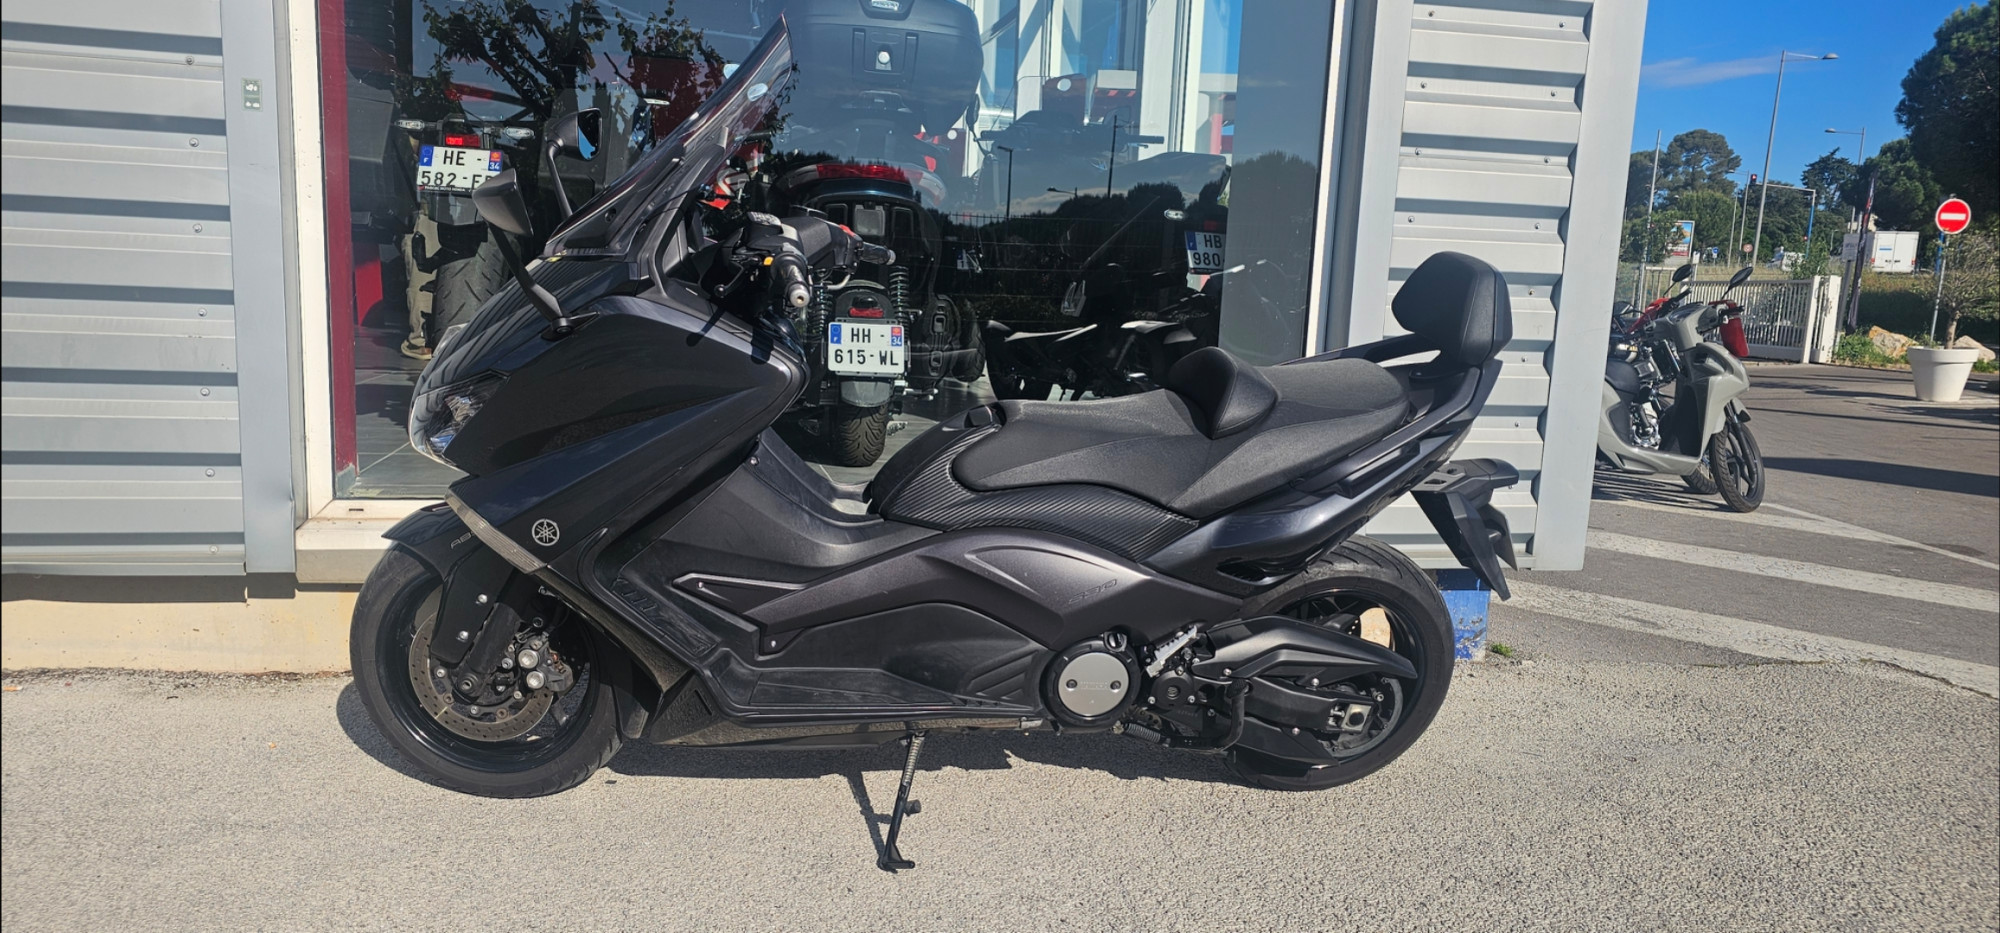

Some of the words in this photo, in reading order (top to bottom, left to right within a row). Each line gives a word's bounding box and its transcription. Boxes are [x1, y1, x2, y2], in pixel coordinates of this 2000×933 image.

[489, 161, 500, 170] 34
[1203, 234, 1222, 248] HB
[891, 337, 902, 346] 34
